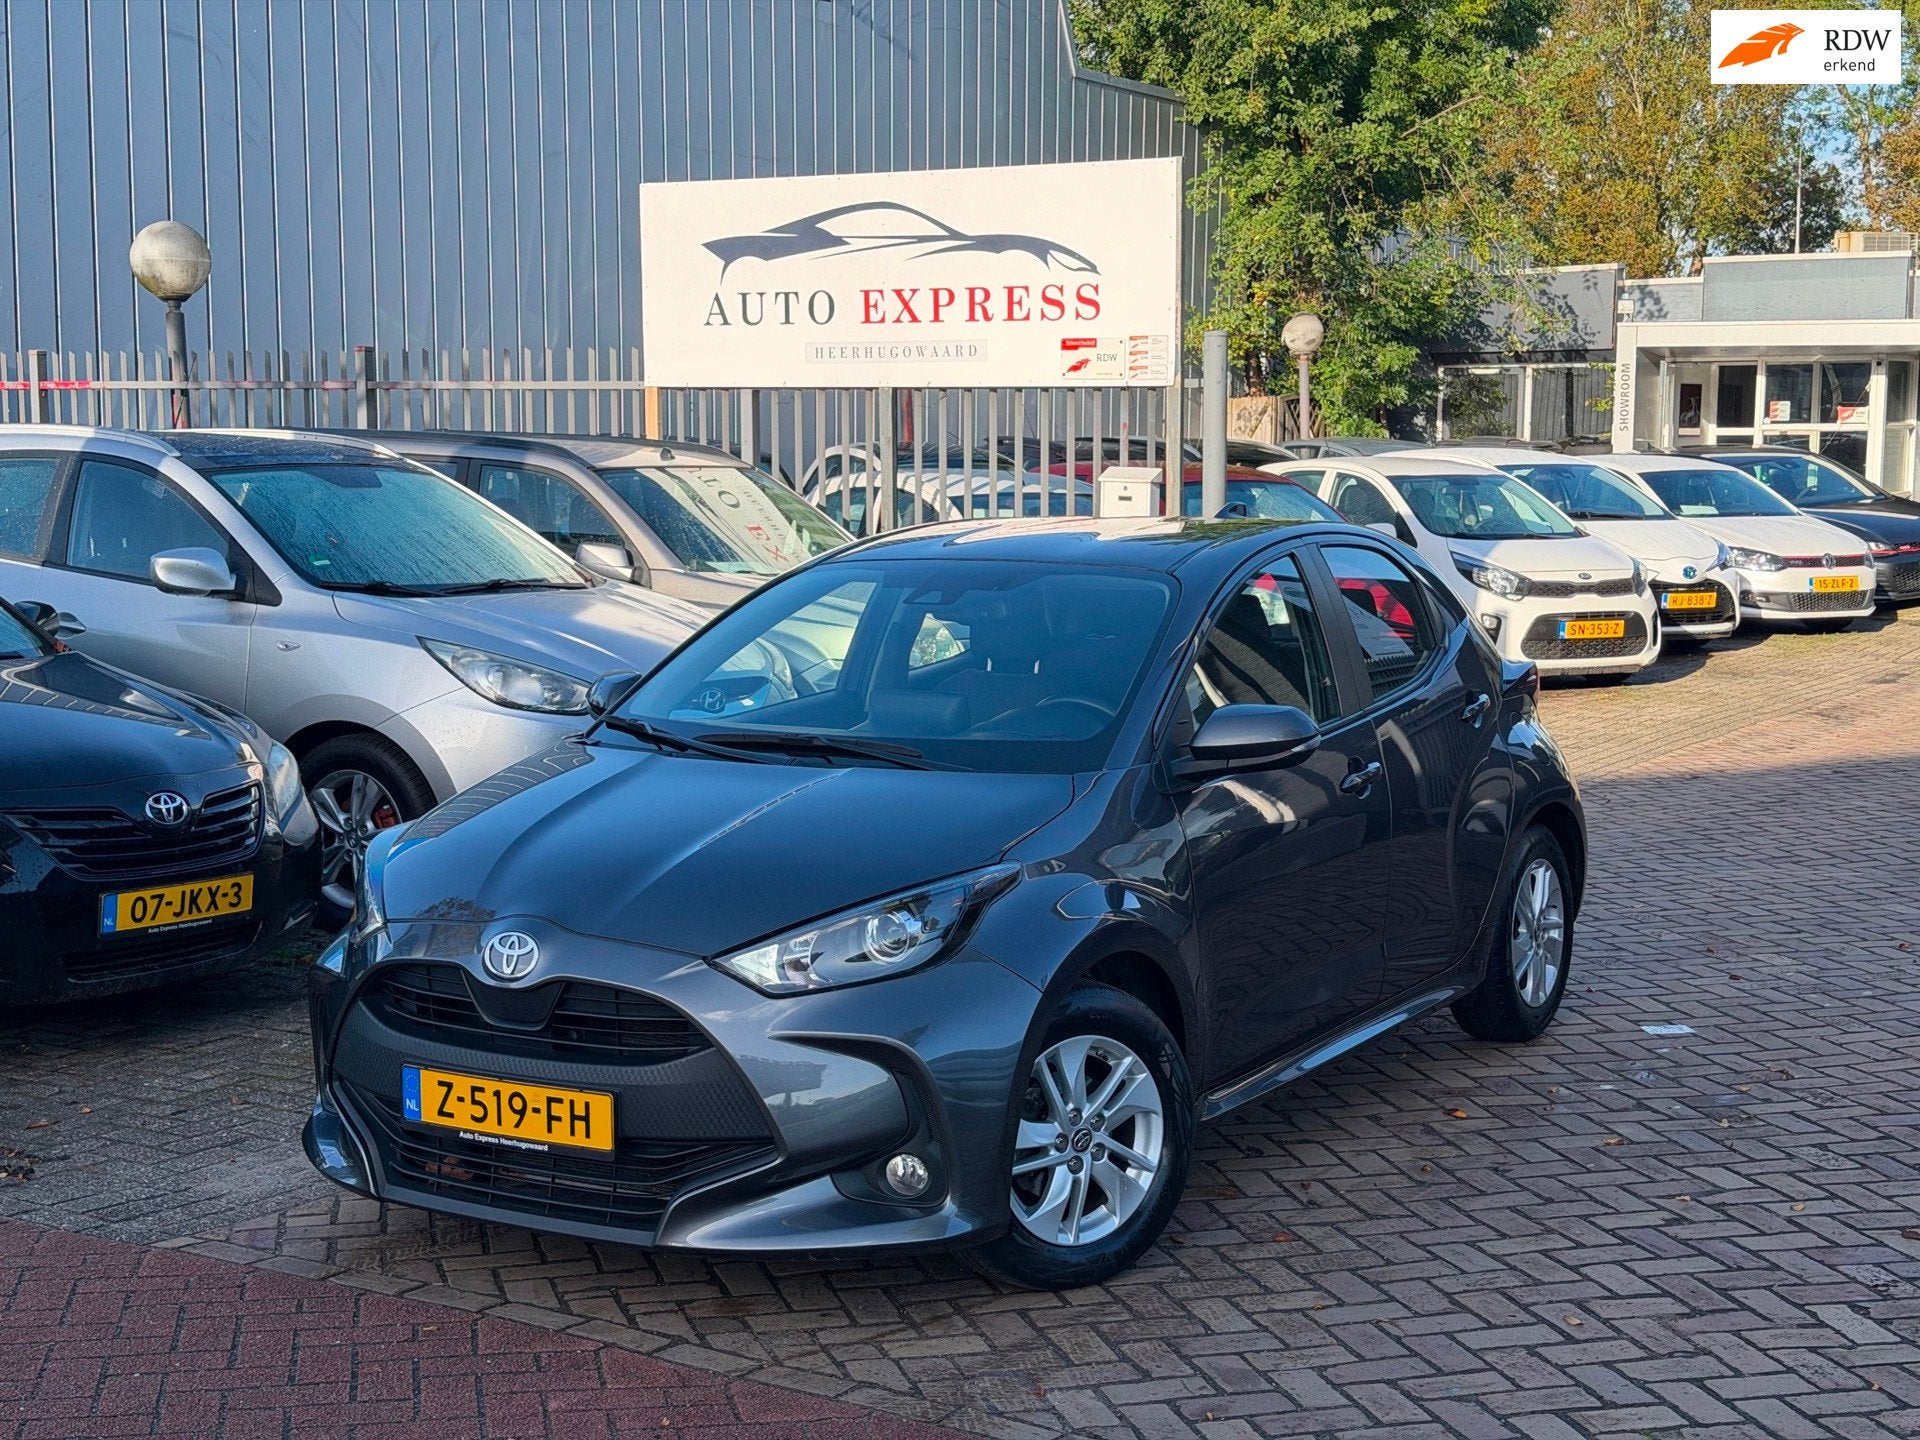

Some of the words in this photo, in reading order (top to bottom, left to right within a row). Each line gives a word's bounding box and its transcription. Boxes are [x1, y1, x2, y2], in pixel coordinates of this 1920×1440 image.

[703, 289, 835, 326] AUTO
[859, 283, 1101, 325] EXPRESS
[814, 343, 978, 360] HEERHUGOWAARD
[1096, 353, 1118, 362] RDW
[1619, 362, 1631, 432] SHOWROOM
[1672, 594, 1713, 606] RJ-838-Z
[1569, 622, 1620, 636] SN-353-Z
[103, 917, 114, 927] NL
[130, 881, 243, 924] 07-JKX-3
[406, 1097, 420, 1112] NL
[436, 1079, 591, 1139] Z-519-FH
[459, 1130, 474, 1140] Auto
[474, 1132, 499, 1144] Express
[499, 1137, 549, 1152] Heerhugowaard
